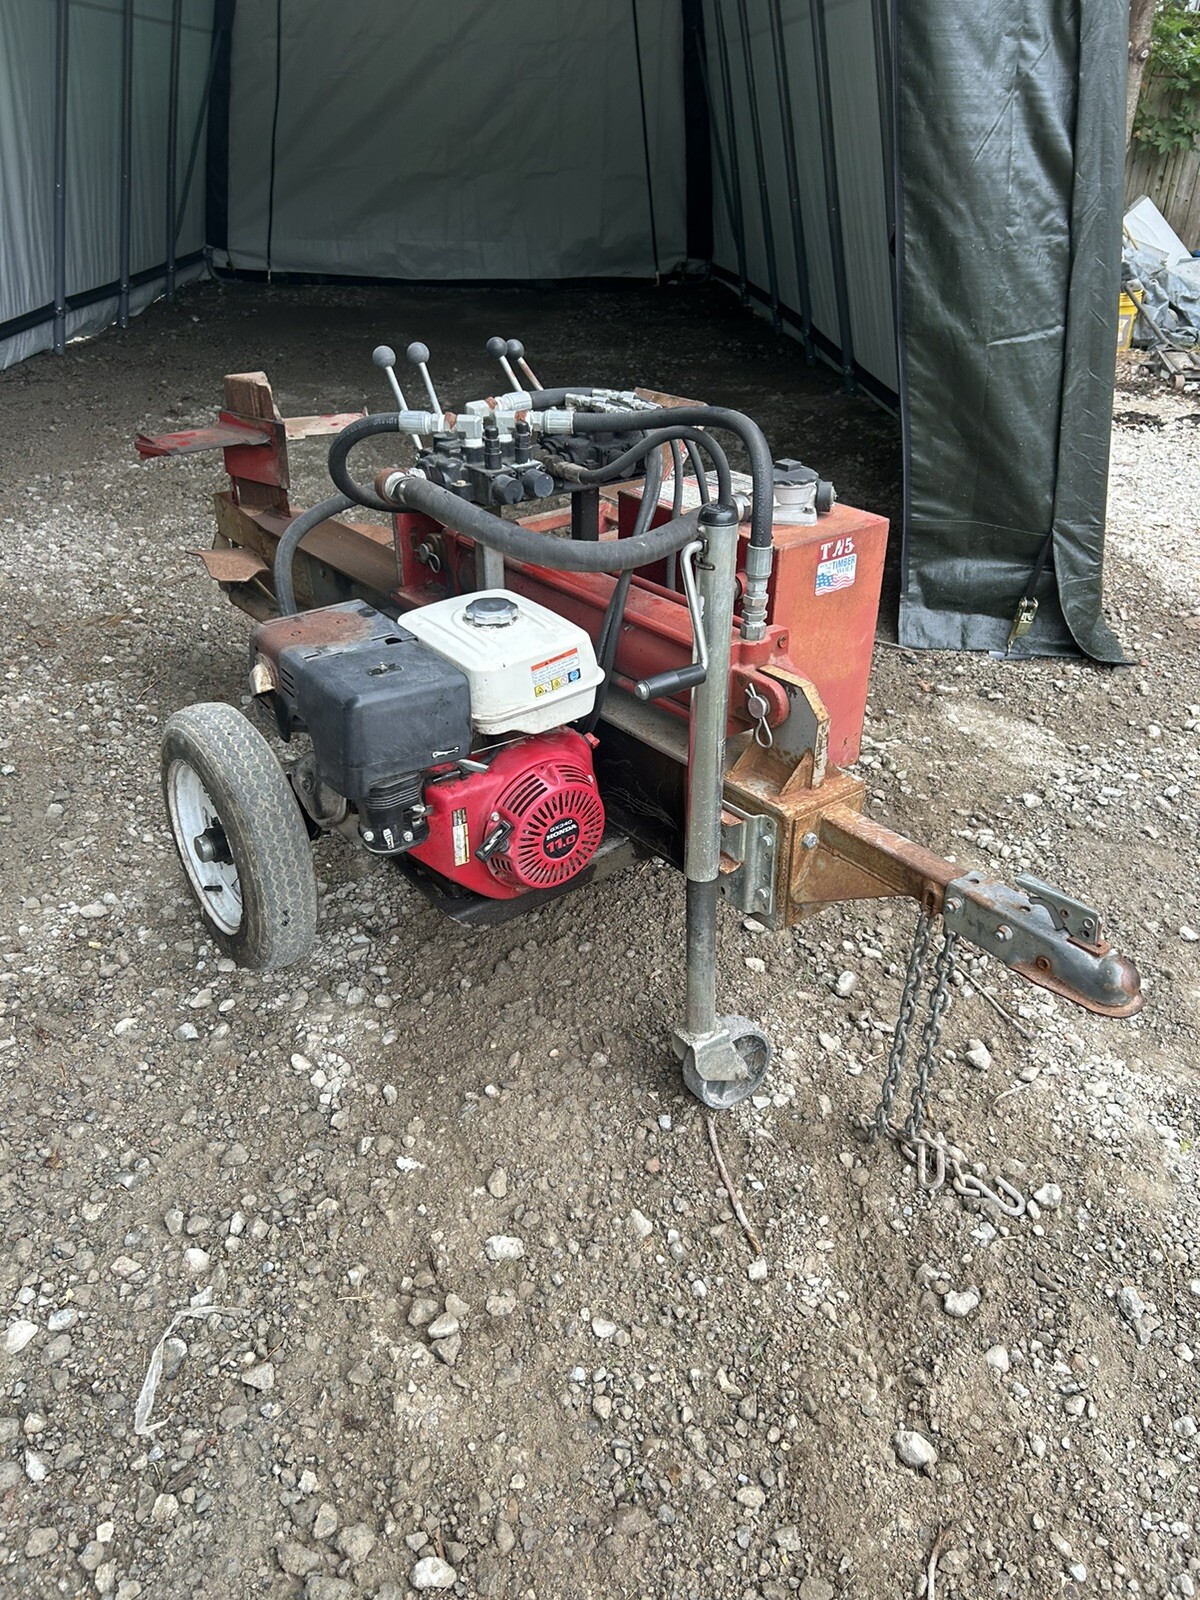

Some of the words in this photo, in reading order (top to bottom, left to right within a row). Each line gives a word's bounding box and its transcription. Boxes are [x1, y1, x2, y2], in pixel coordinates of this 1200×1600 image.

[832, 555, 855, 570] TIMBER
[546, 823, 577, 841] HONDA
[550, 819, 573, 833] GX340
[546, 834, 576, 853] 11.0
